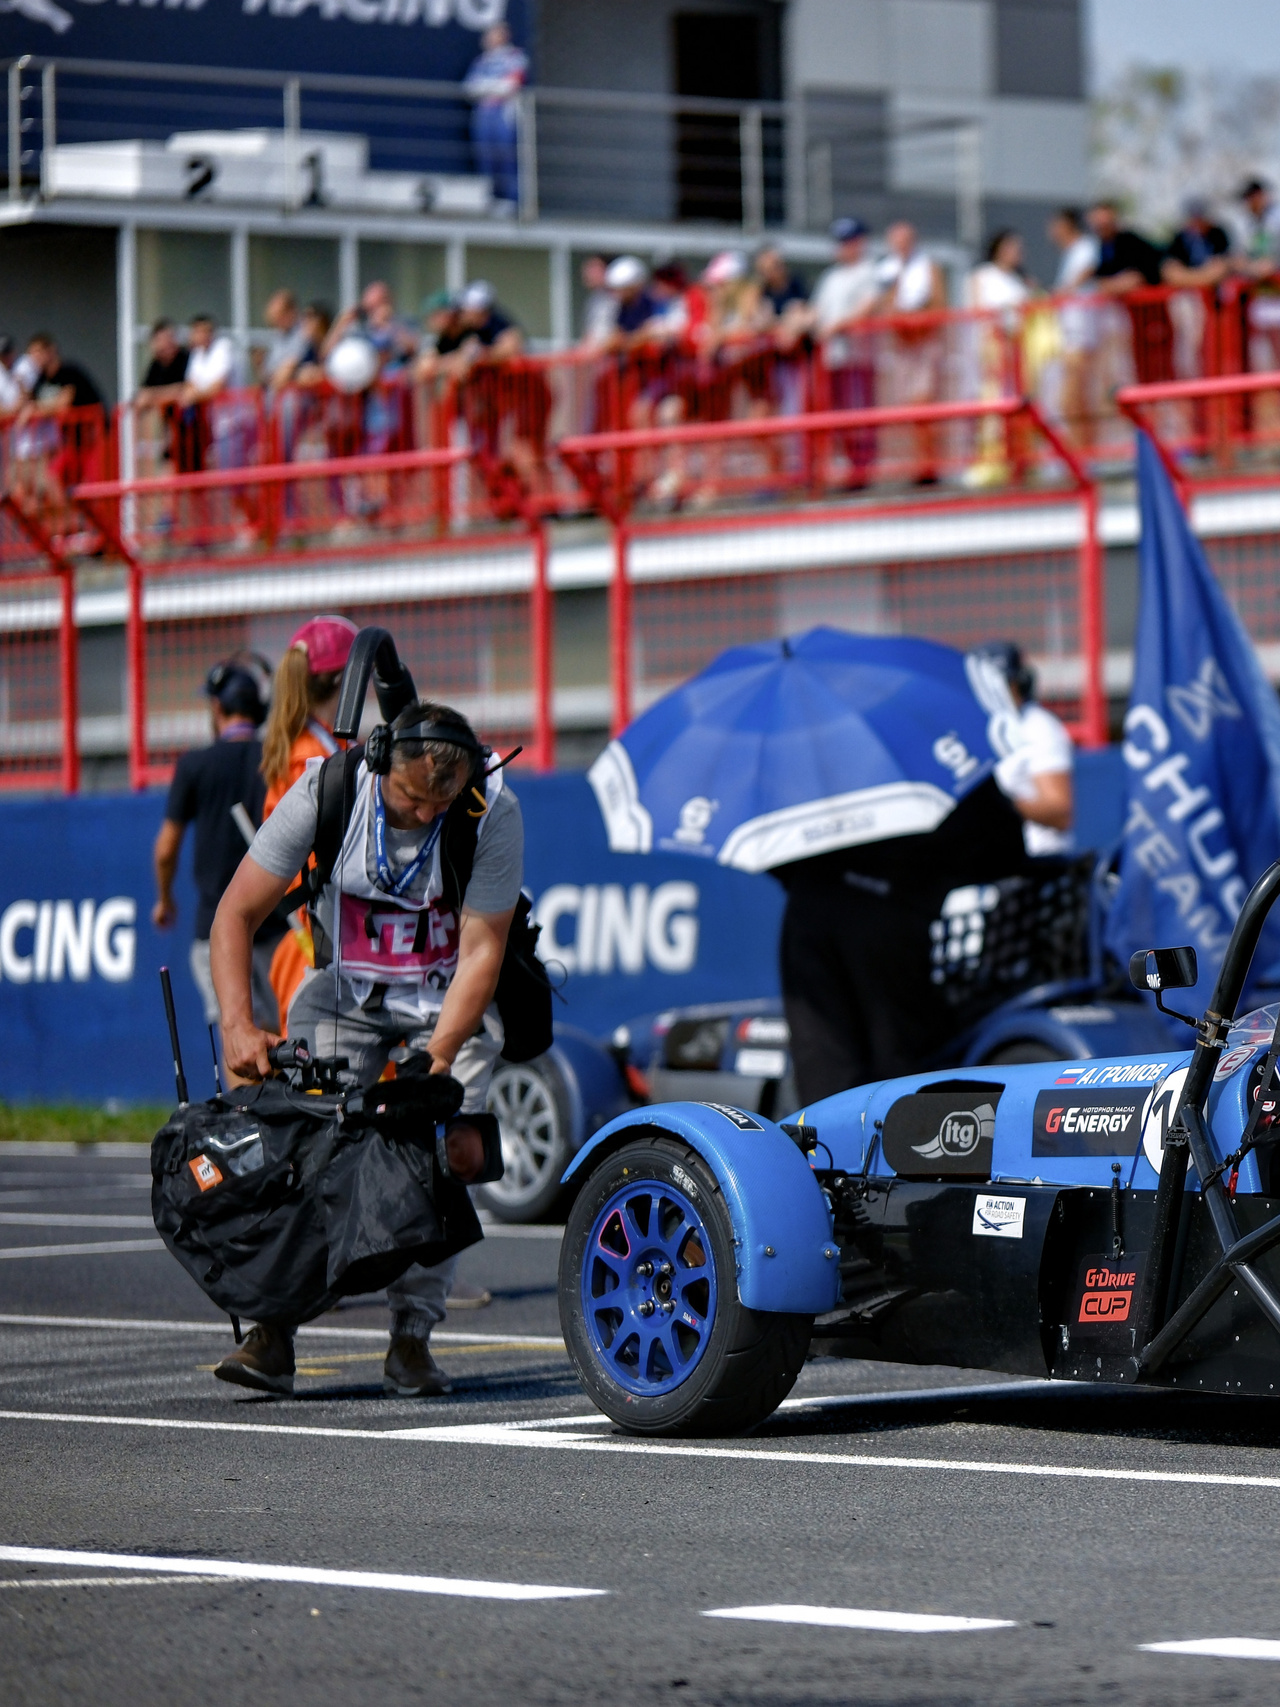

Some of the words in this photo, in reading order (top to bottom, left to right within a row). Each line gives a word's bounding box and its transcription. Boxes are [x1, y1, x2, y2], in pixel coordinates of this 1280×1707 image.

[526, 880, 700, 977] CING
[0, 897, 137, 983] CING
[1076, 1063, 1169, 1085] А.ГРОМОВ
[945, 1119, 975, 1149] itg
[991, 1210, 1004, 1219] ROAD
[1004, 1211, 1021, 1220] SAFETY
[994, 1201, 1015, 1211] ACTION
[1084, 1297, 1127, 1315] CUP
